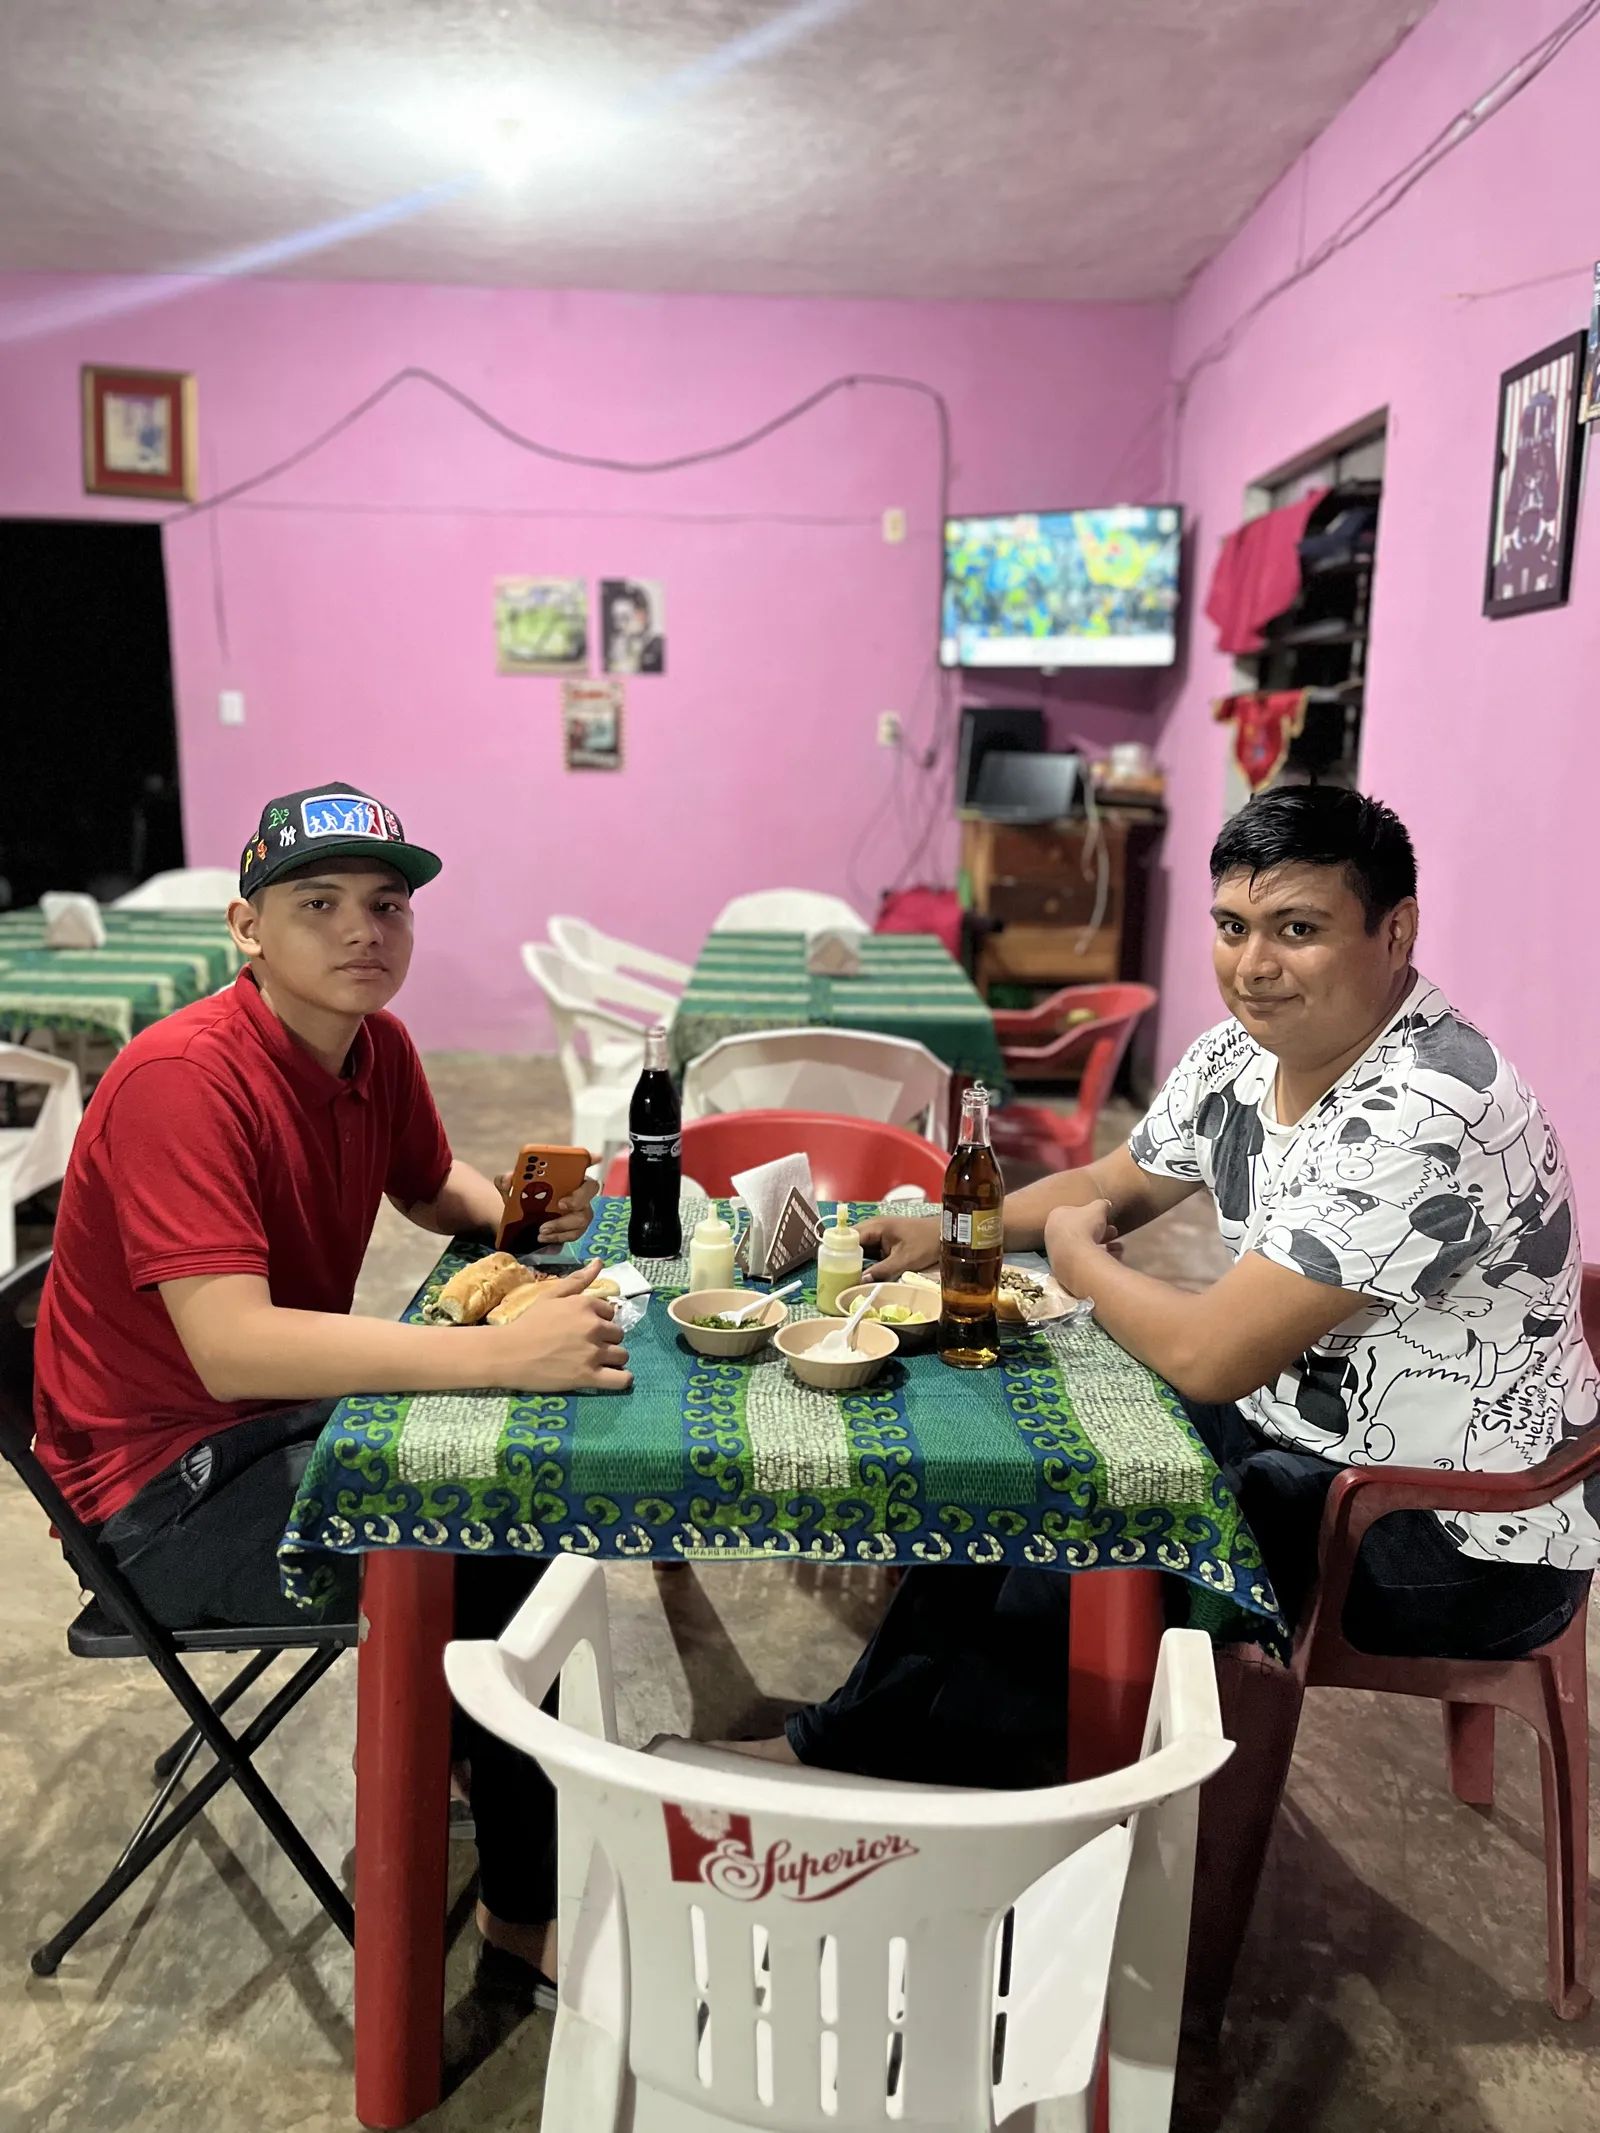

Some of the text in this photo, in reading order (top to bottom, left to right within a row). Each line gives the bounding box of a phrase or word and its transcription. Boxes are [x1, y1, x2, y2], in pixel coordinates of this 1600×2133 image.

[1206, 1031, 1249, 1063] WHO
[1513, 1384, 1538, 1431] WHO
[700, 1835, 920, 1902] Superior
